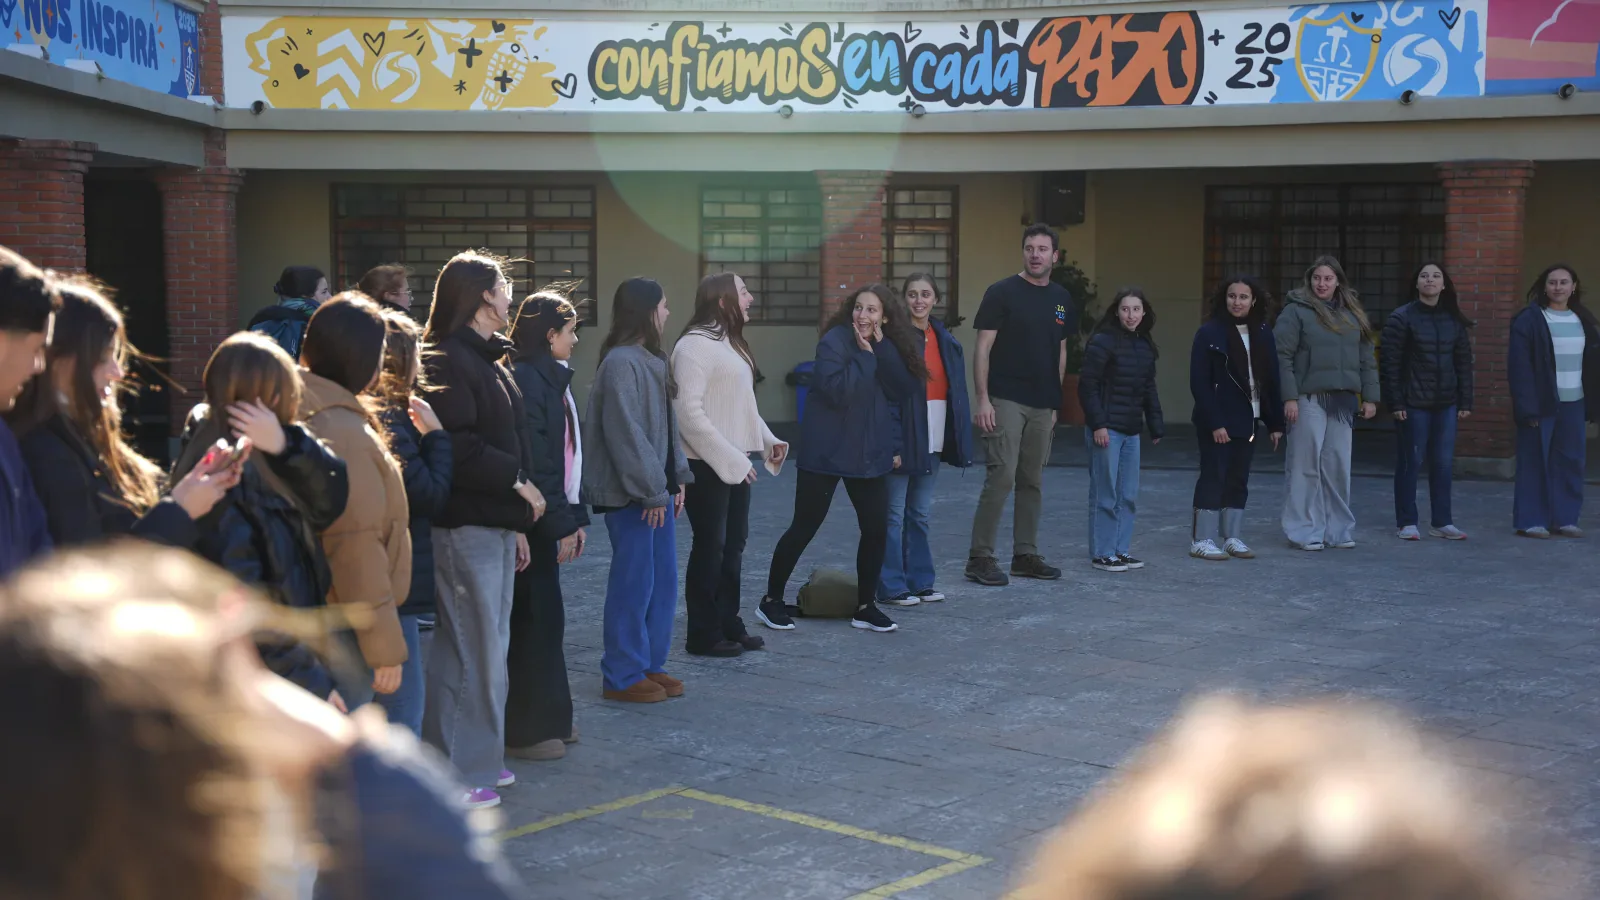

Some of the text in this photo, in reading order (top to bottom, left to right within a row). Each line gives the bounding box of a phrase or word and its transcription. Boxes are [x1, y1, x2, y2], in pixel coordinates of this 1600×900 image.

[80, 0, 159, 70] INSPIRA
[177, 10, 197, 33] 2024
[1234, 22, 1292, 55] 20
[840, 33, 904, 95] en
[909, 21, 1022, 104] cada
[1025, 11, 1200, 107] PASO
[1225, 57, 1284, 89] 25
